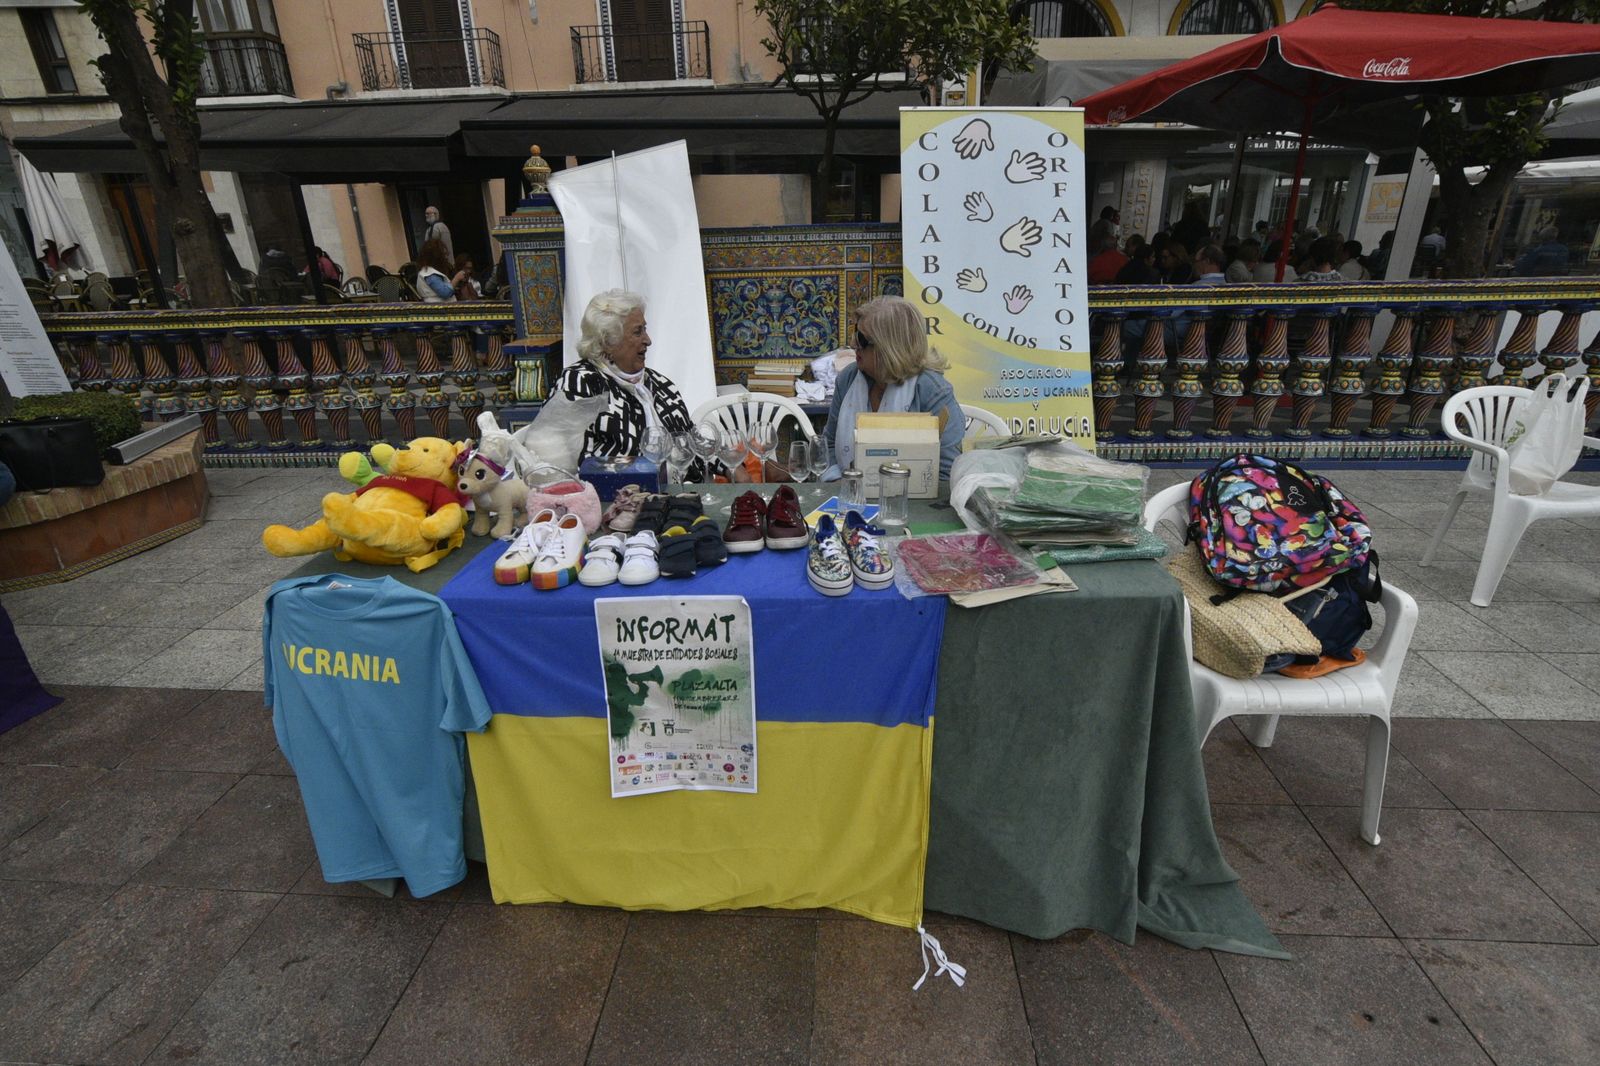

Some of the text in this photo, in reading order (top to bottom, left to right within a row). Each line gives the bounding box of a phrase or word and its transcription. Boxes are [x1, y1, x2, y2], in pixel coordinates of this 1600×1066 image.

[918, 131, 944, 336] COLABOR
[1047, 131, 1074, 352] ORFANATOS
[962, 311, 1038, 349] con los
[1022, 386, 1039, 398] DE
[1043, 386, 1090, 398] UCRANIA
[621, 648, 654, 661] MUESTRA
[654, 648, 664, 661] DE
[665, 647, 703, 660] ENTIDADES
[671, 678, 738, 693] PLAZA ALTA
